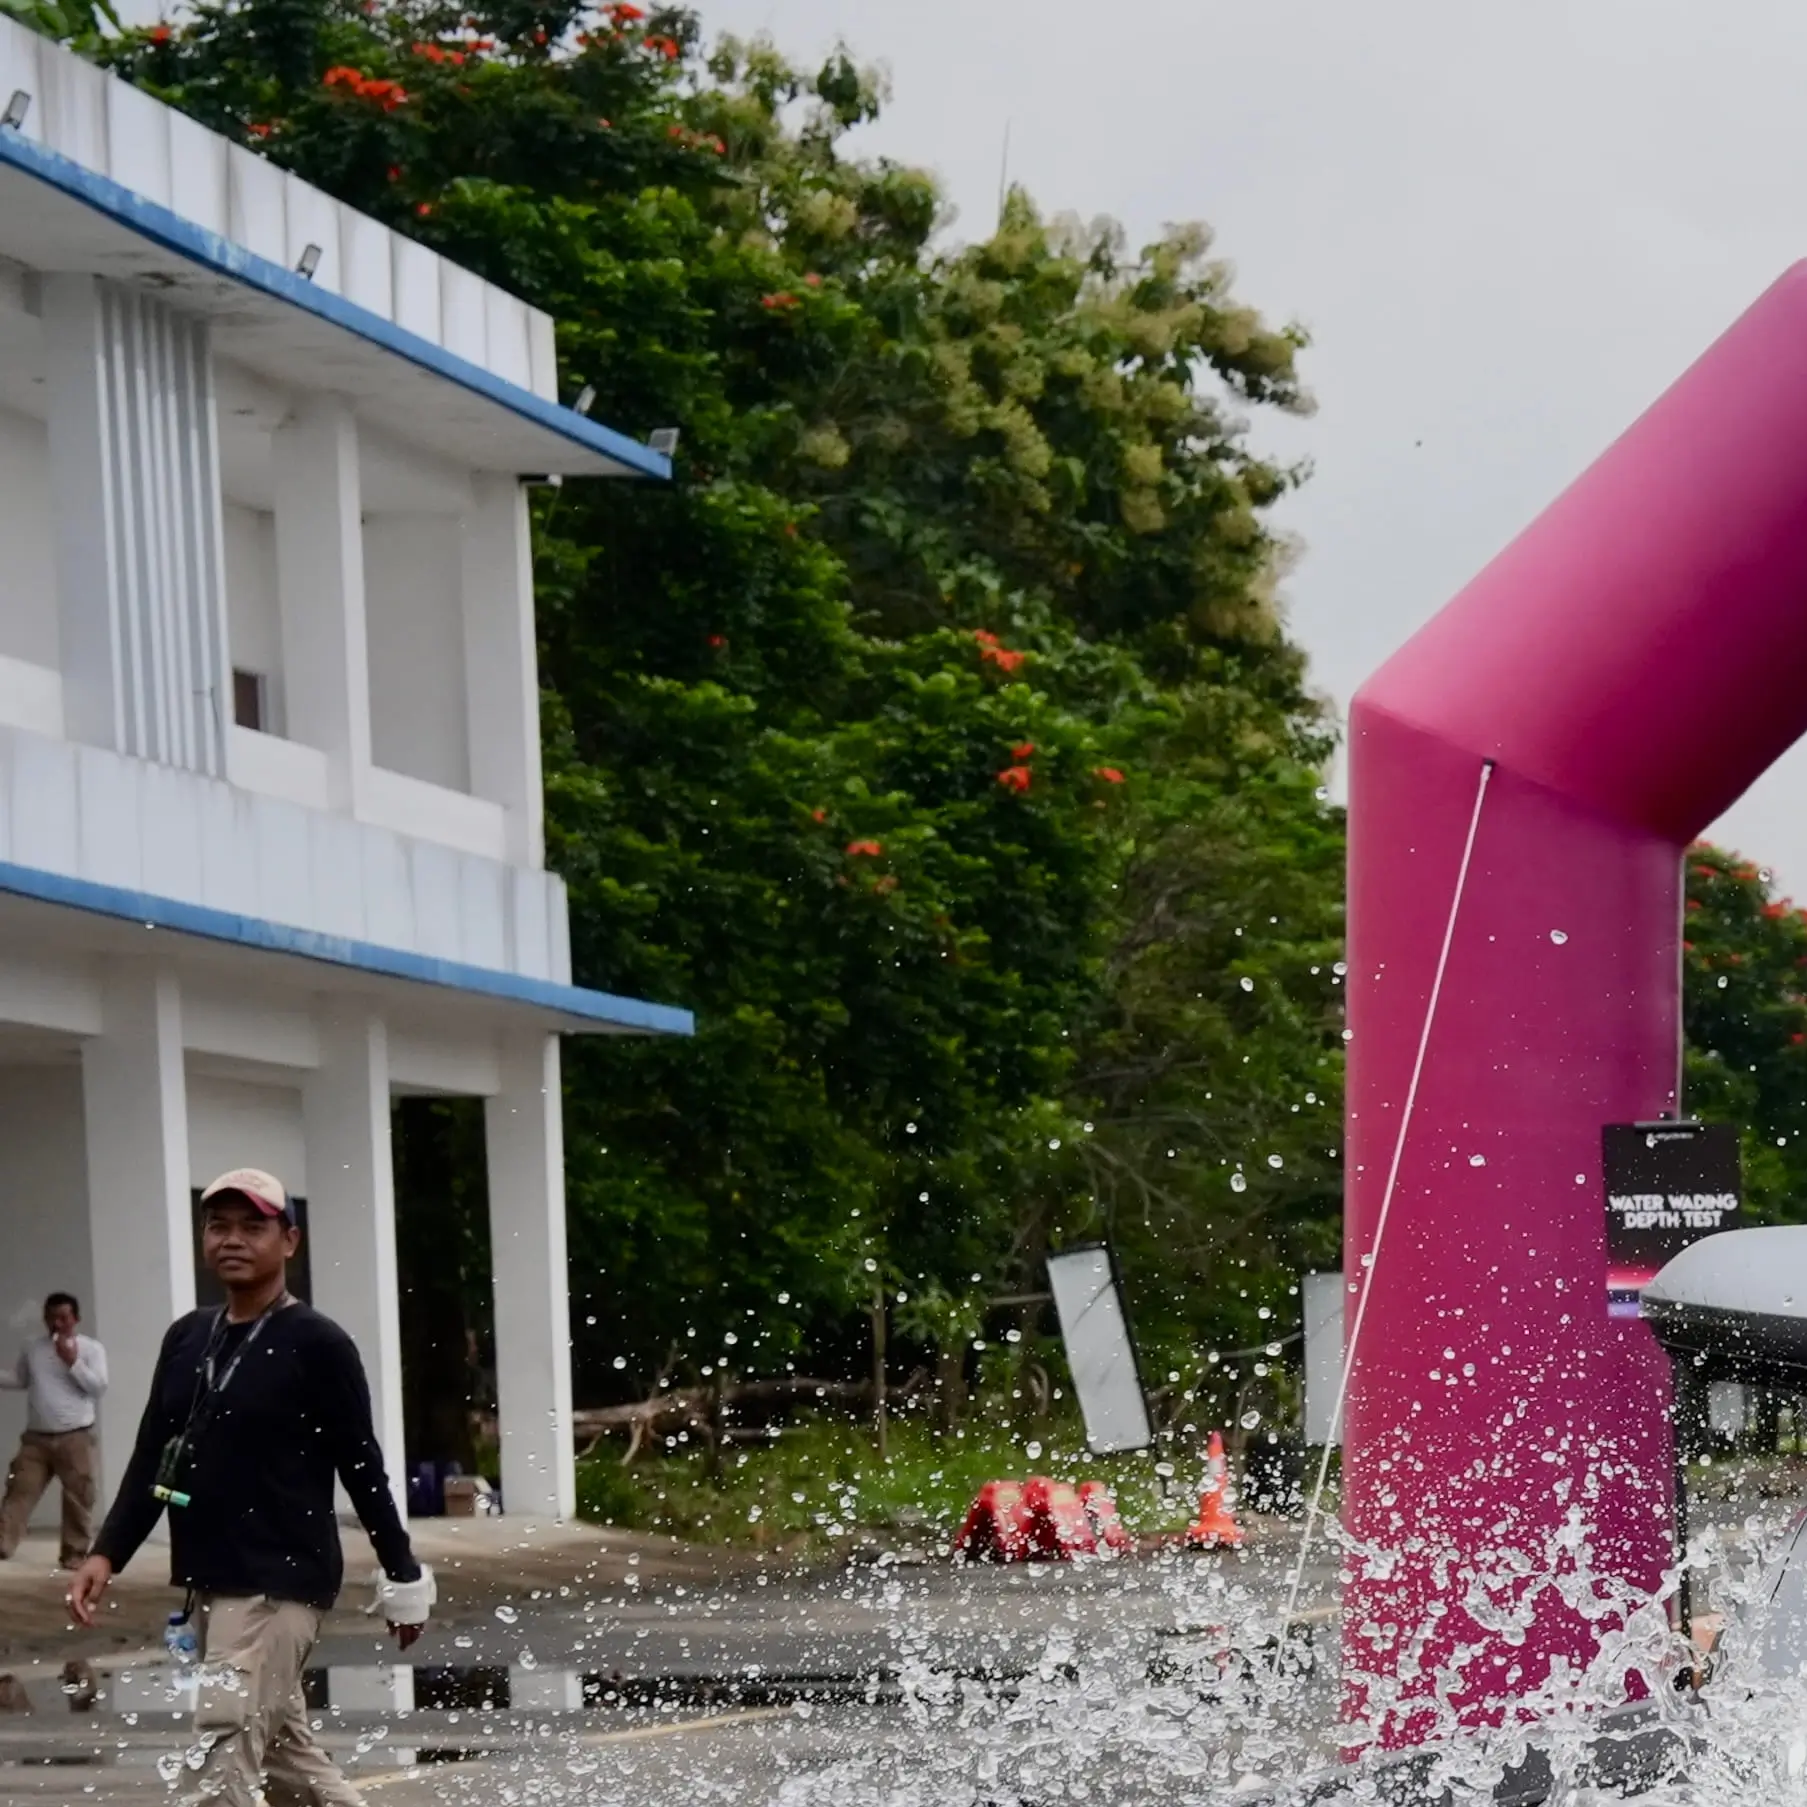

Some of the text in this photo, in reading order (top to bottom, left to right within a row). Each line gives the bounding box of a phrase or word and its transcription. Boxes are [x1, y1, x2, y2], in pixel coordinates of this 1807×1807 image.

[1609, 1194, 1738, 1211] WATER WADING
[1624, 1211, 1723, 1228] DEPTH TEST
